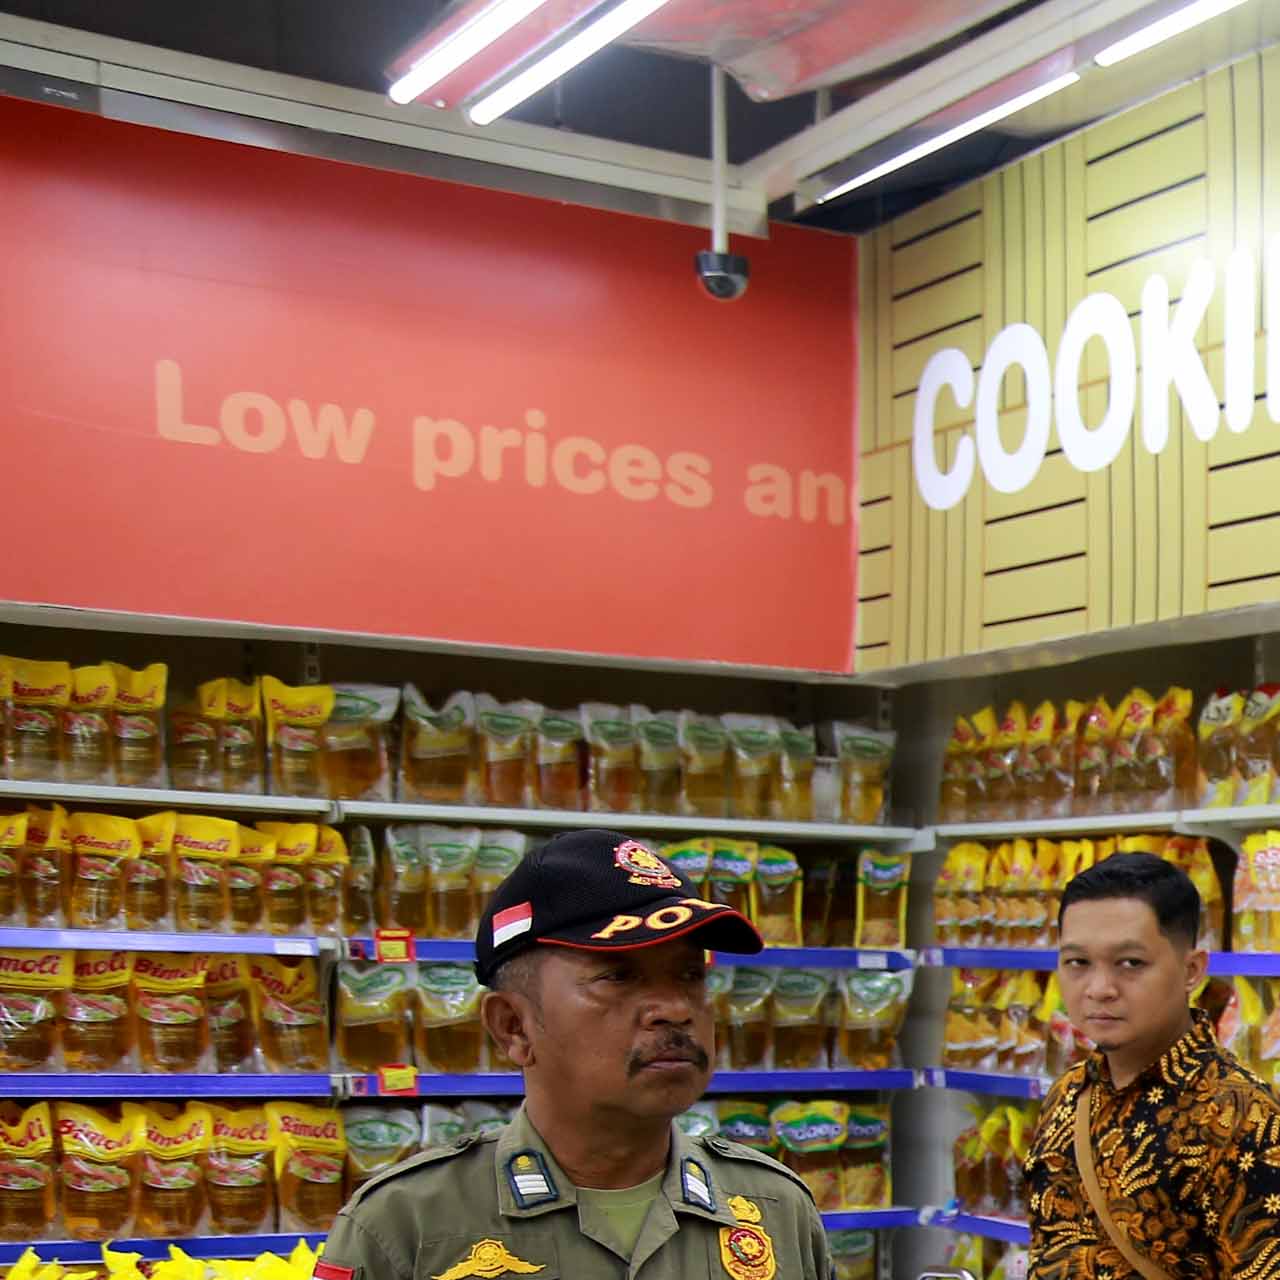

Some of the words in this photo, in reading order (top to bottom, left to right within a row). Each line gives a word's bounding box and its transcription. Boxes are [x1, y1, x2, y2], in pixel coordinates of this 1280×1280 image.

[155, 359, 375, 465] Low
[412, 408, 713, 508] prices
[744, 459, 857, 526] an
[0, 954, 60, 977] moli
[75, 951, 128, 980] moli
[147, 1119, 204, 1146] imoli
[281, 1114, 339, 1140] Bimoli
